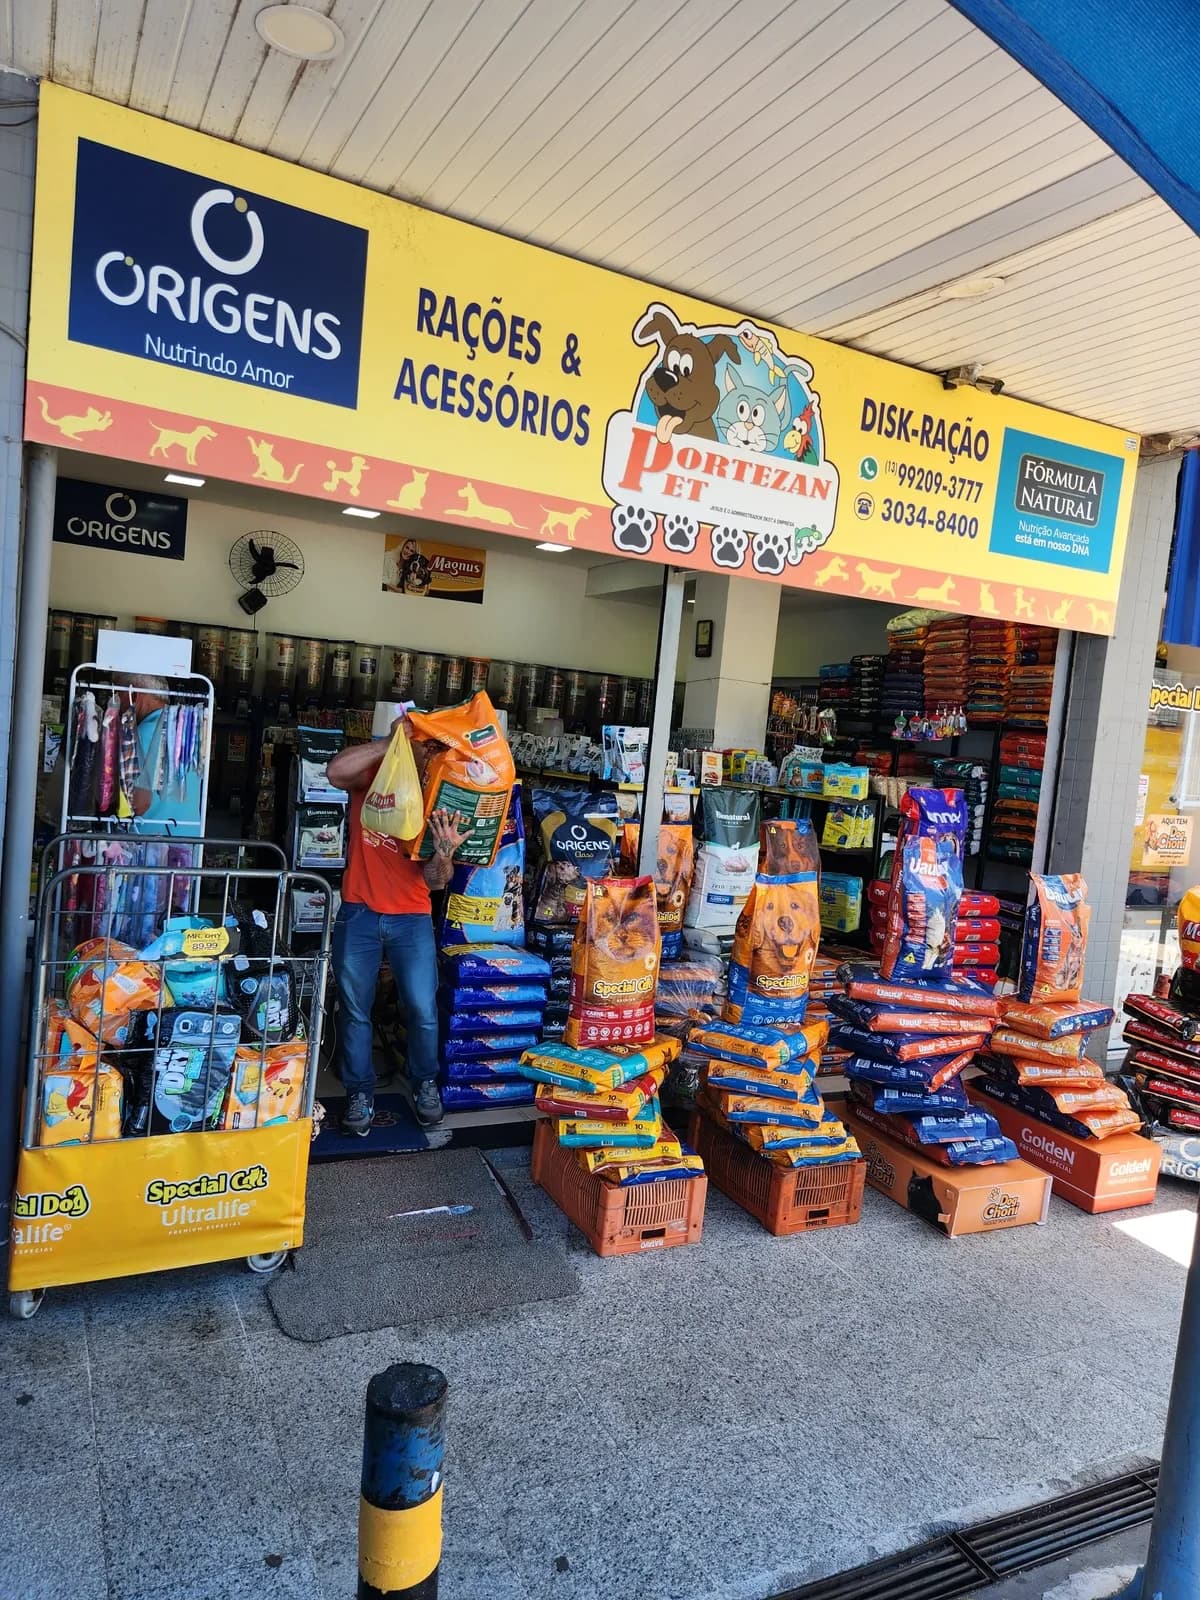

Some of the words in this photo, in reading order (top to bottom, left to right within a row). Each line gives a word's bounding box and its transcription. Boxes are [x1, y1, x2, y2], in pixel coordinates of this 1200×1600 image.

[95, 251, 342, 361] ORIGENS
[416, 287, 543, 365] RAÇÕES
[561, 333, 581, 377] &
[144, 333, 238, 376] Nutrindo
[240, 359, 295, 389] Amor
[393, 357, 591, 446] ACESSÓRIOS
[860, 397, 990, 464] DISK-RAÇÃO
[617, 426, 833, 501] PORTEZAN
[1024, 459, 1098, 496] FÓRMULA
[898, 463, 984, 504] 99209-3777
[881, 497, 979, 540] 3034-8400
[1020, 485, 1095, 521] NATURAL
[67, 516, 171, 550] ORIGENS
[1015, 533, 1032, 545] está
[1033, 538, 1047, 548] em
[1047, 540, 1071, 553] nosso
[1071, 544, 1090, 557] DNA
[1018, 520, 1053, 538] Nutrição
[1053, 528, 1090, 545] Avançada
[427, 557, 481, 576] Magnus
[1150, 684, 1193, 710] pecial
[1161, 817, 1176, 826] AQUI
[556, 840, 611, 851] ORIGENS
[594, 980, 636, 999] Special
[756, 974, 797, 991] Special
[164, 1048, 190, 1087] DRY
[1021, 1128, 1076, 1166] GoldeN
[1109, 1157, 1152, 1177] GoldeN
[40, 1185, 90, 1217] Dog
[147, 1172, 228, 1205] Special
[229, 1165, 268, 1192] Cat
[999, 1193, 1019, 1207] Dog
[161, 1199, 251, 1227] Ultralife
[982, 1201, 1020, 1221] Choni
